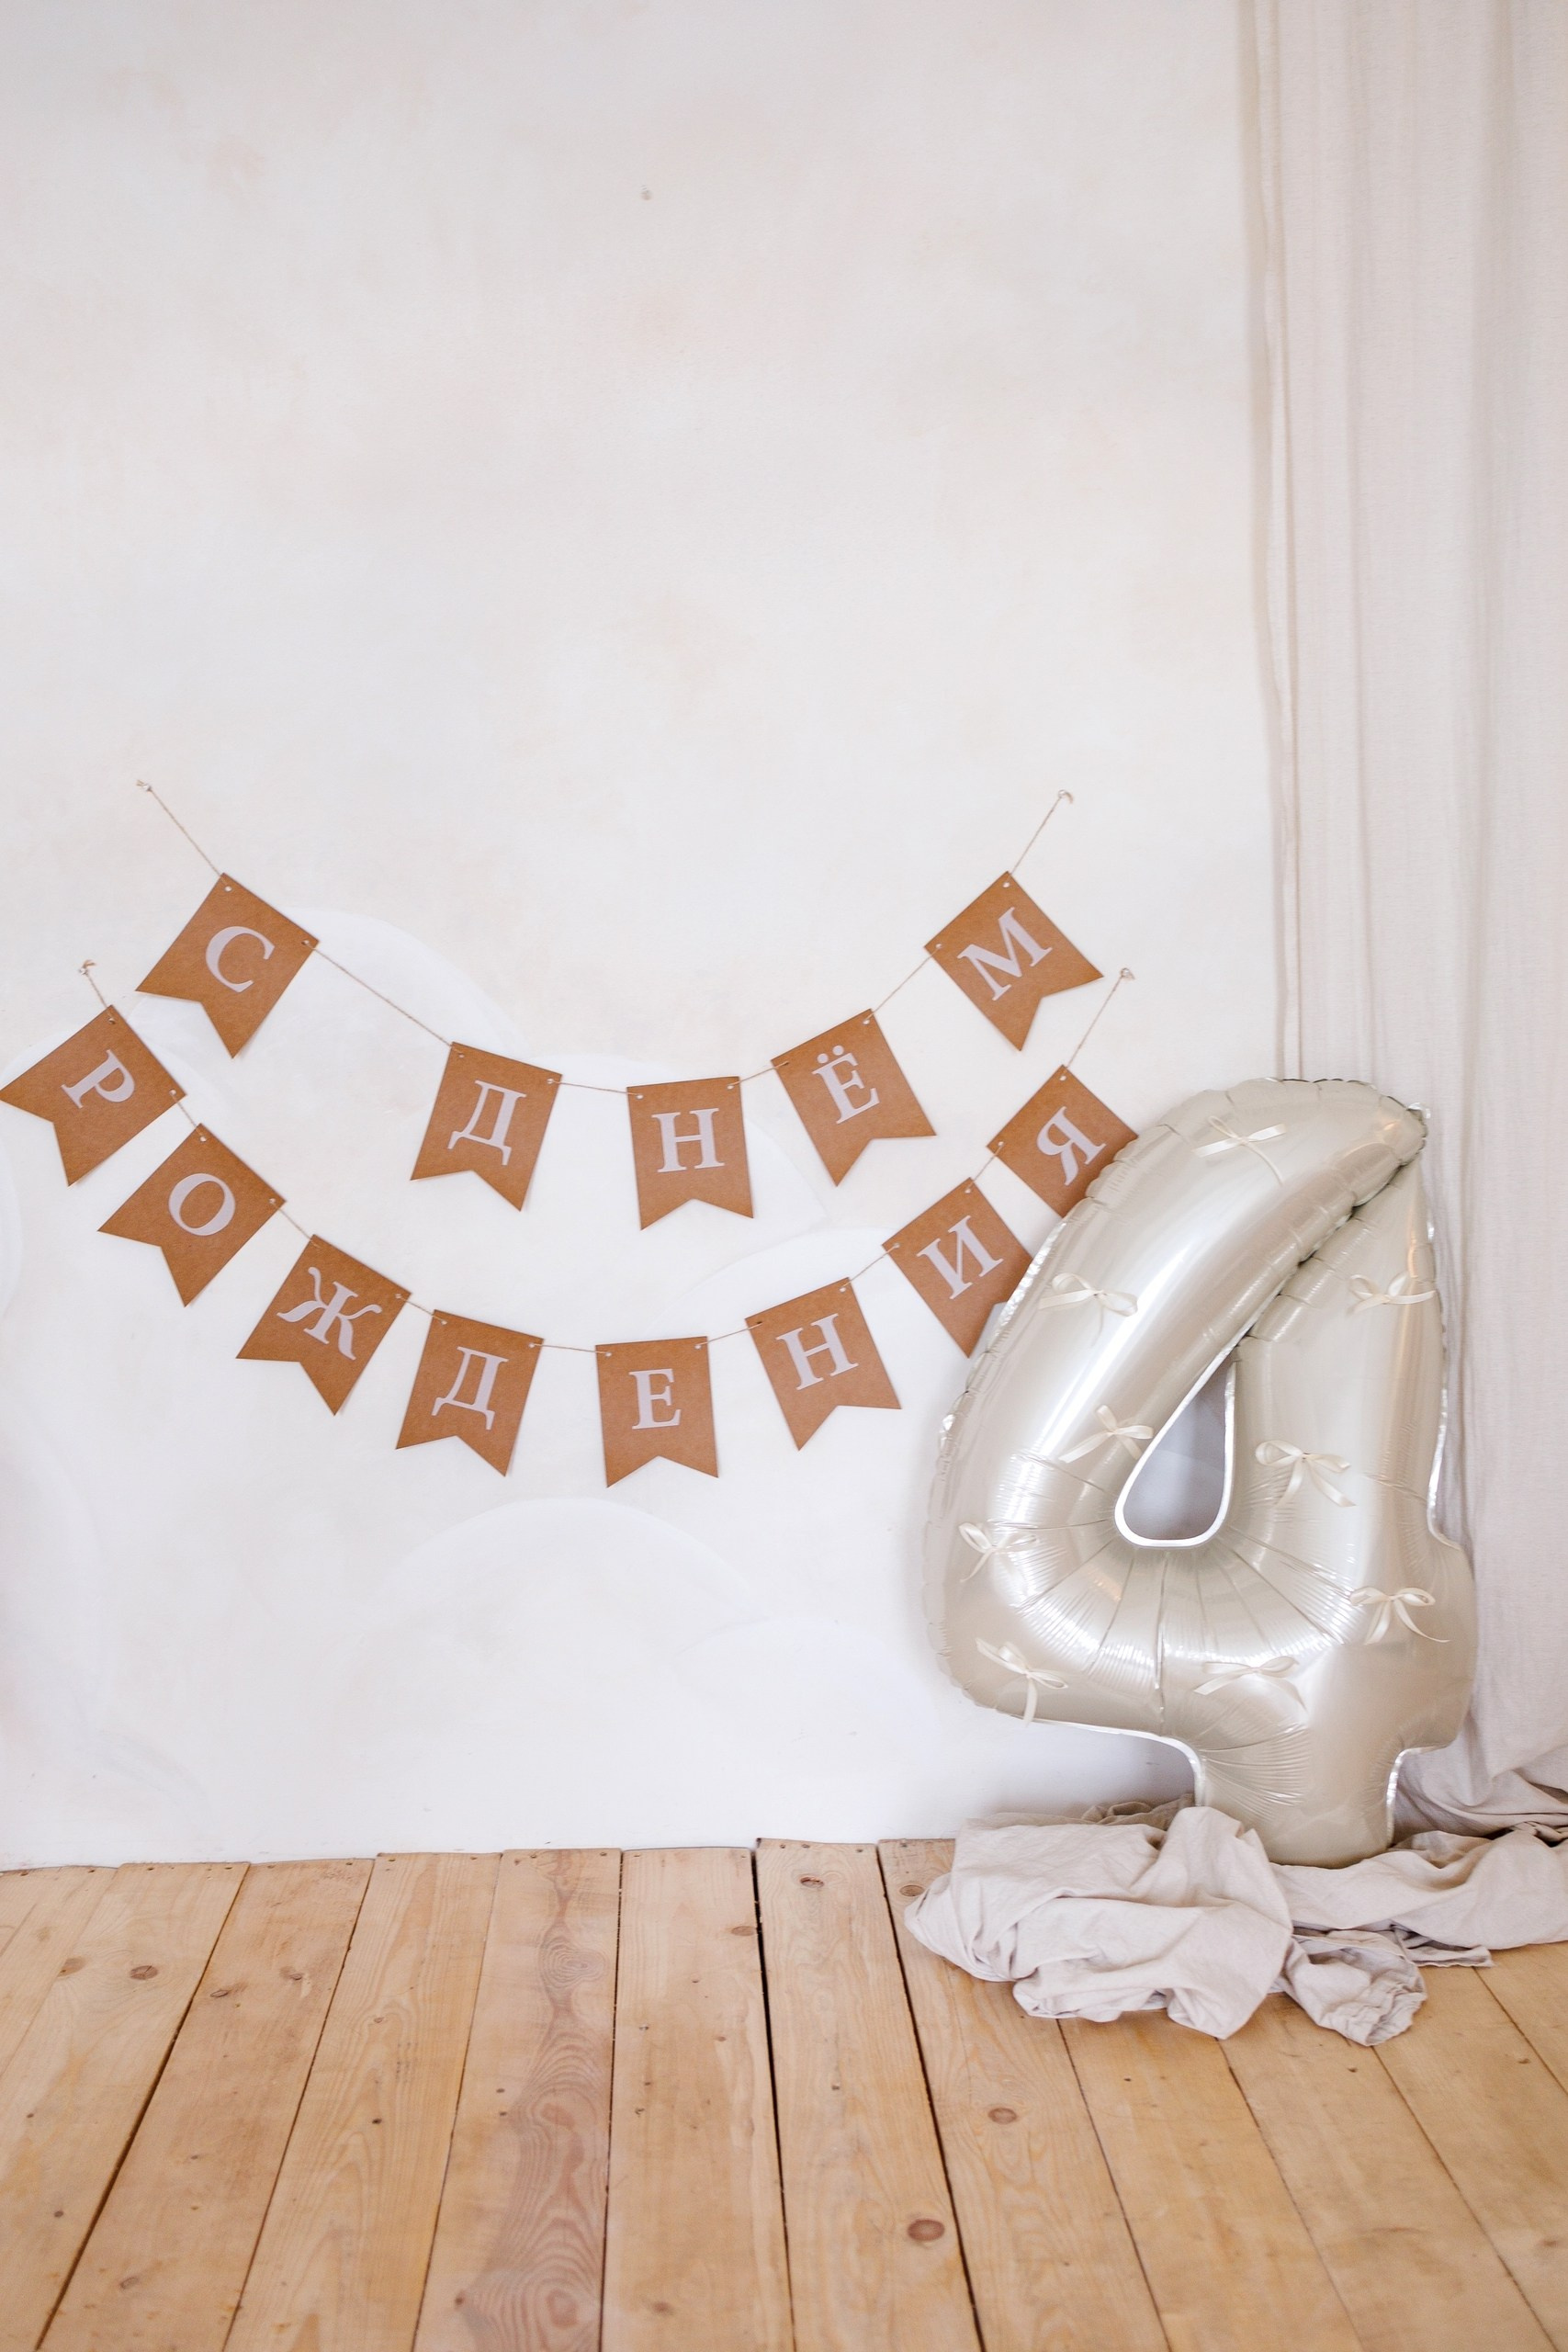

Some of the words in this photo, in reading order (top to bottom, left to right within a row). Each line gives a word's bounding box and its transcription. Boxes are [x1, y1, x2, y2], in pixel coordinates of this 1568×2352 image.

[204, 925, 276, 993] С
[447, 906, 1053, 1174] ДНЁМ
[61, 1048, 1106, 1431] РОЖДЕНИЯ
[921, 1077, 1478, 1869] 4
